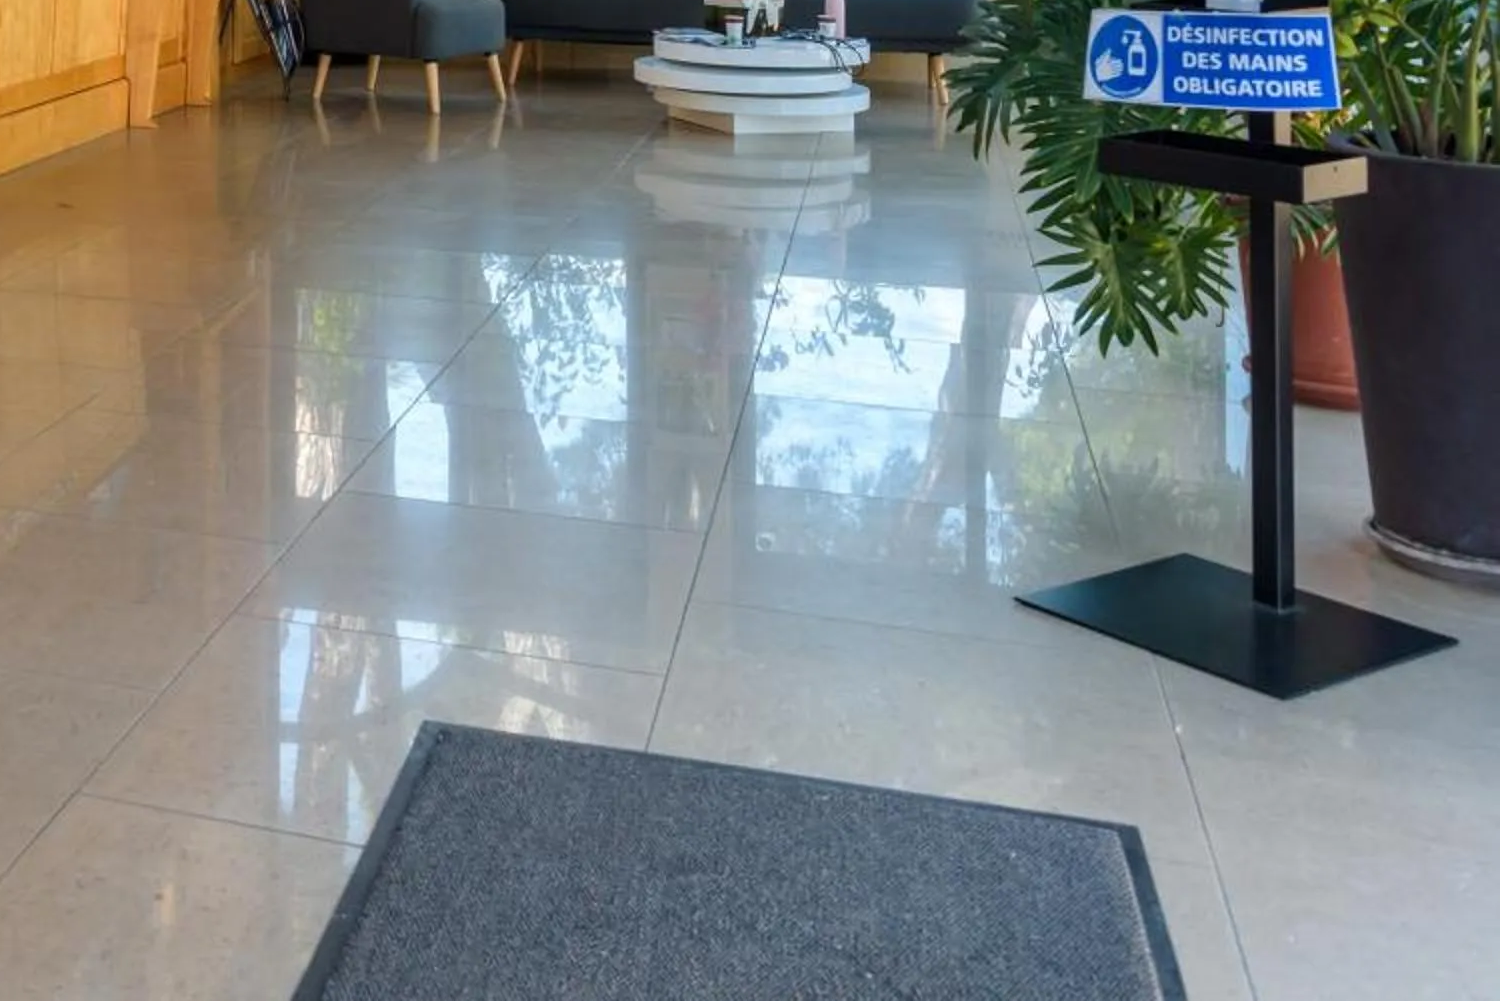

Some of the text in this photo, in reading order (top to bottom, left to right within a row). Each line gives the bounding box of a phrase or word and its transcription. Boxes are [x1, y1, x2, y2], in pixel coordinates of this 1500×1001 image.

[1167, 23, 1323, 47] DÉSINFECTION
[1182, 52, 1308, 72] DES MAINS
[1173, 76, 1323, 98] OBLIGATOIRE
